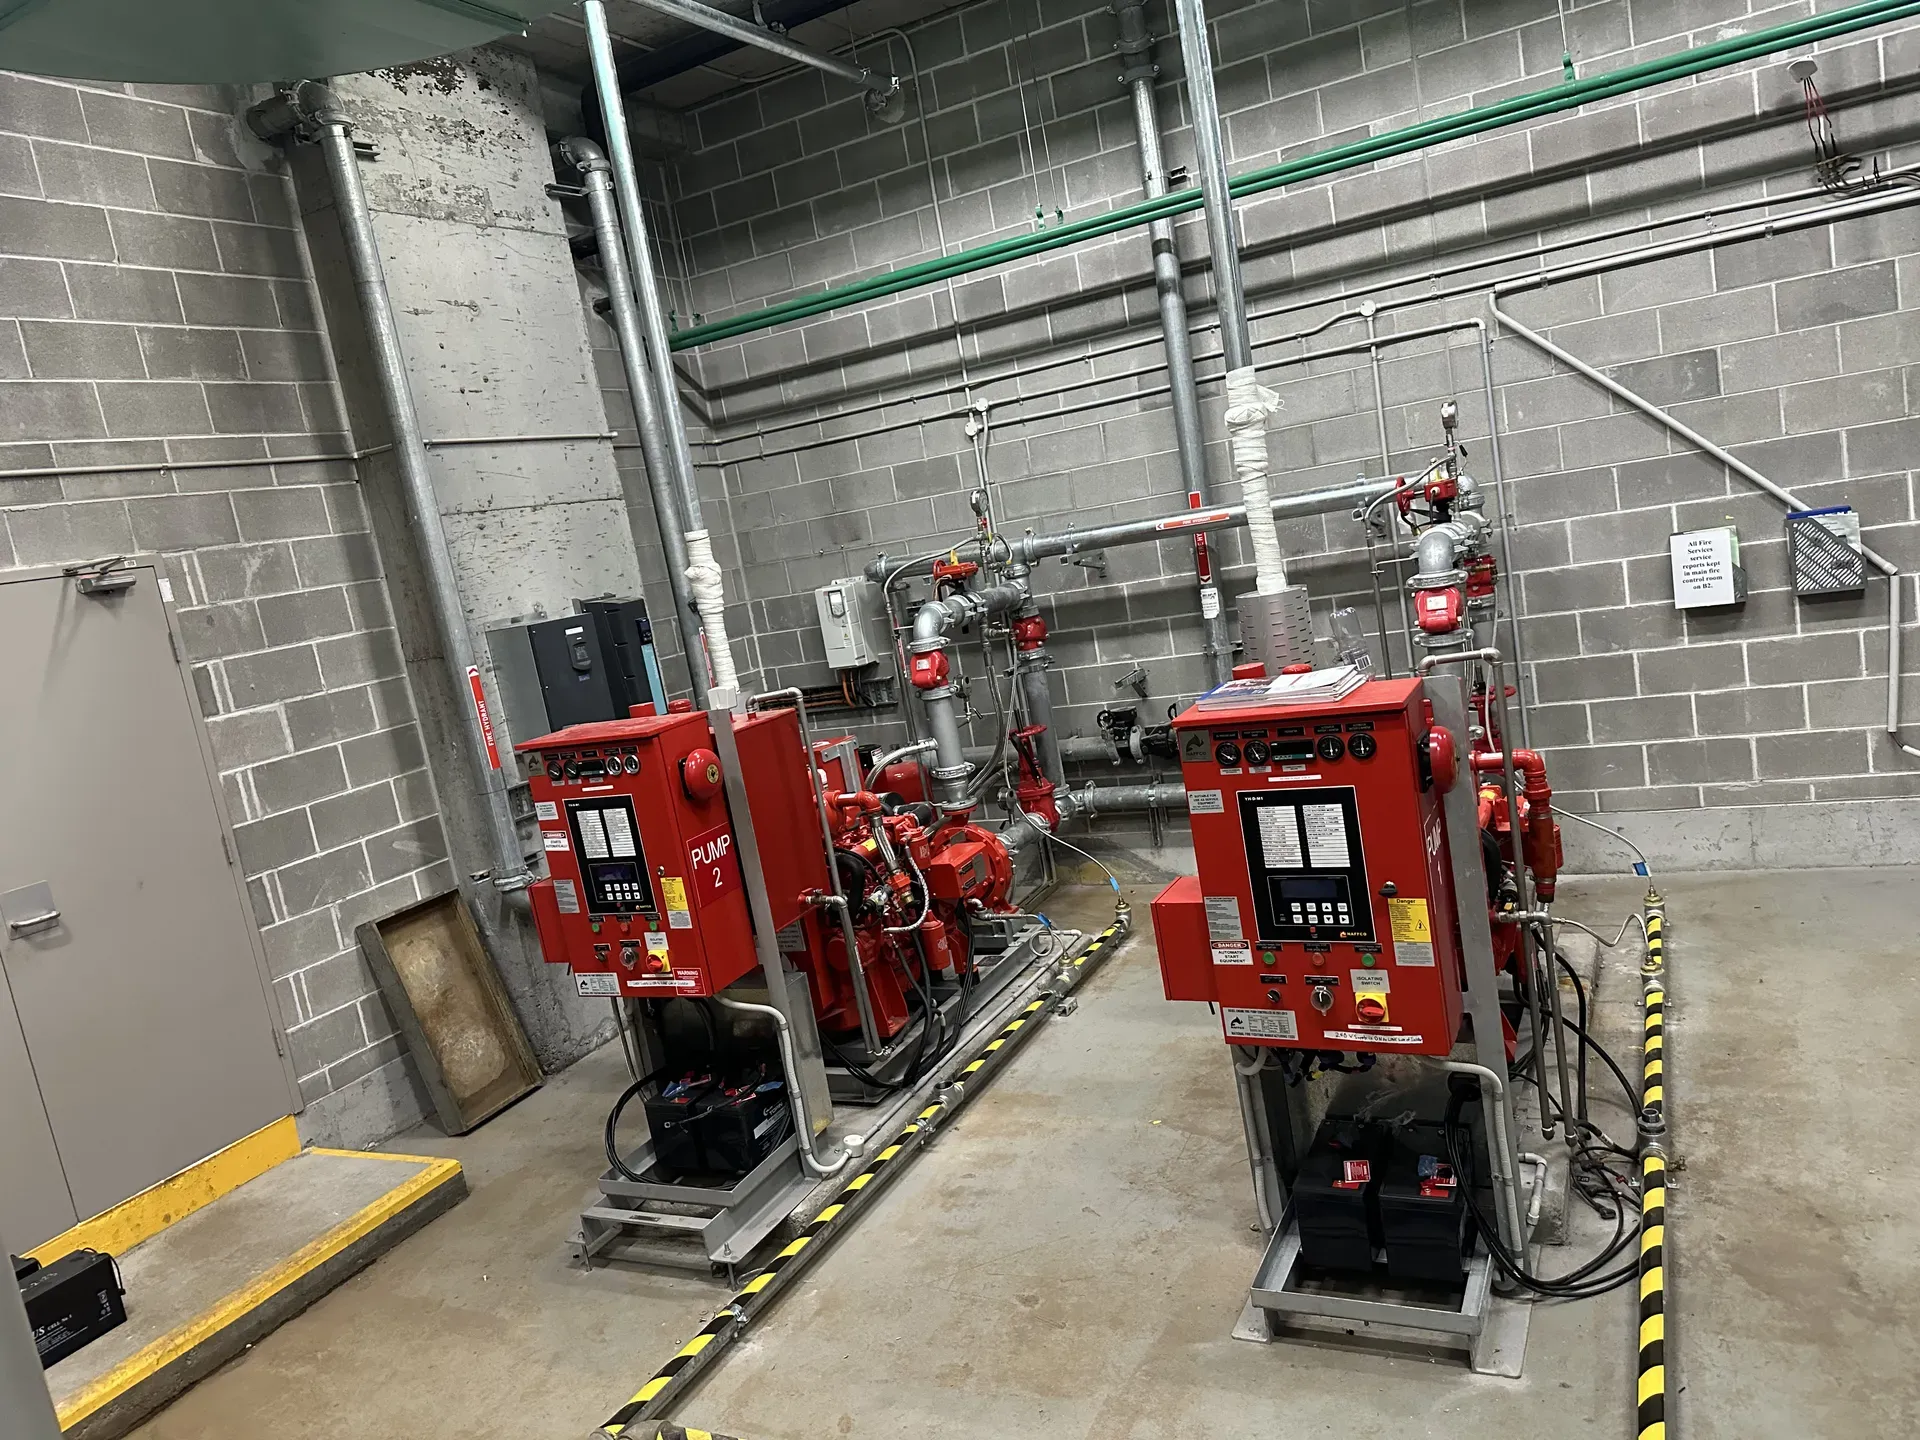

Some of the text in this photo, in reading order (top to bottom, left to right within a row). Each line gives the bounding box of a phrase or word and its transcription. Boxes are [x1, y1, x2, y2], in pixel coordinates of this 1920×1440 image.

[478, 700, 495, 747] FIRE HYDRANT
[691, 834, 730, 870] PUMP
[1427, 817, 1441, 863] PUMP
[712, 867, 723, 888] 2
[1437, 860, 1443, 885] 1
